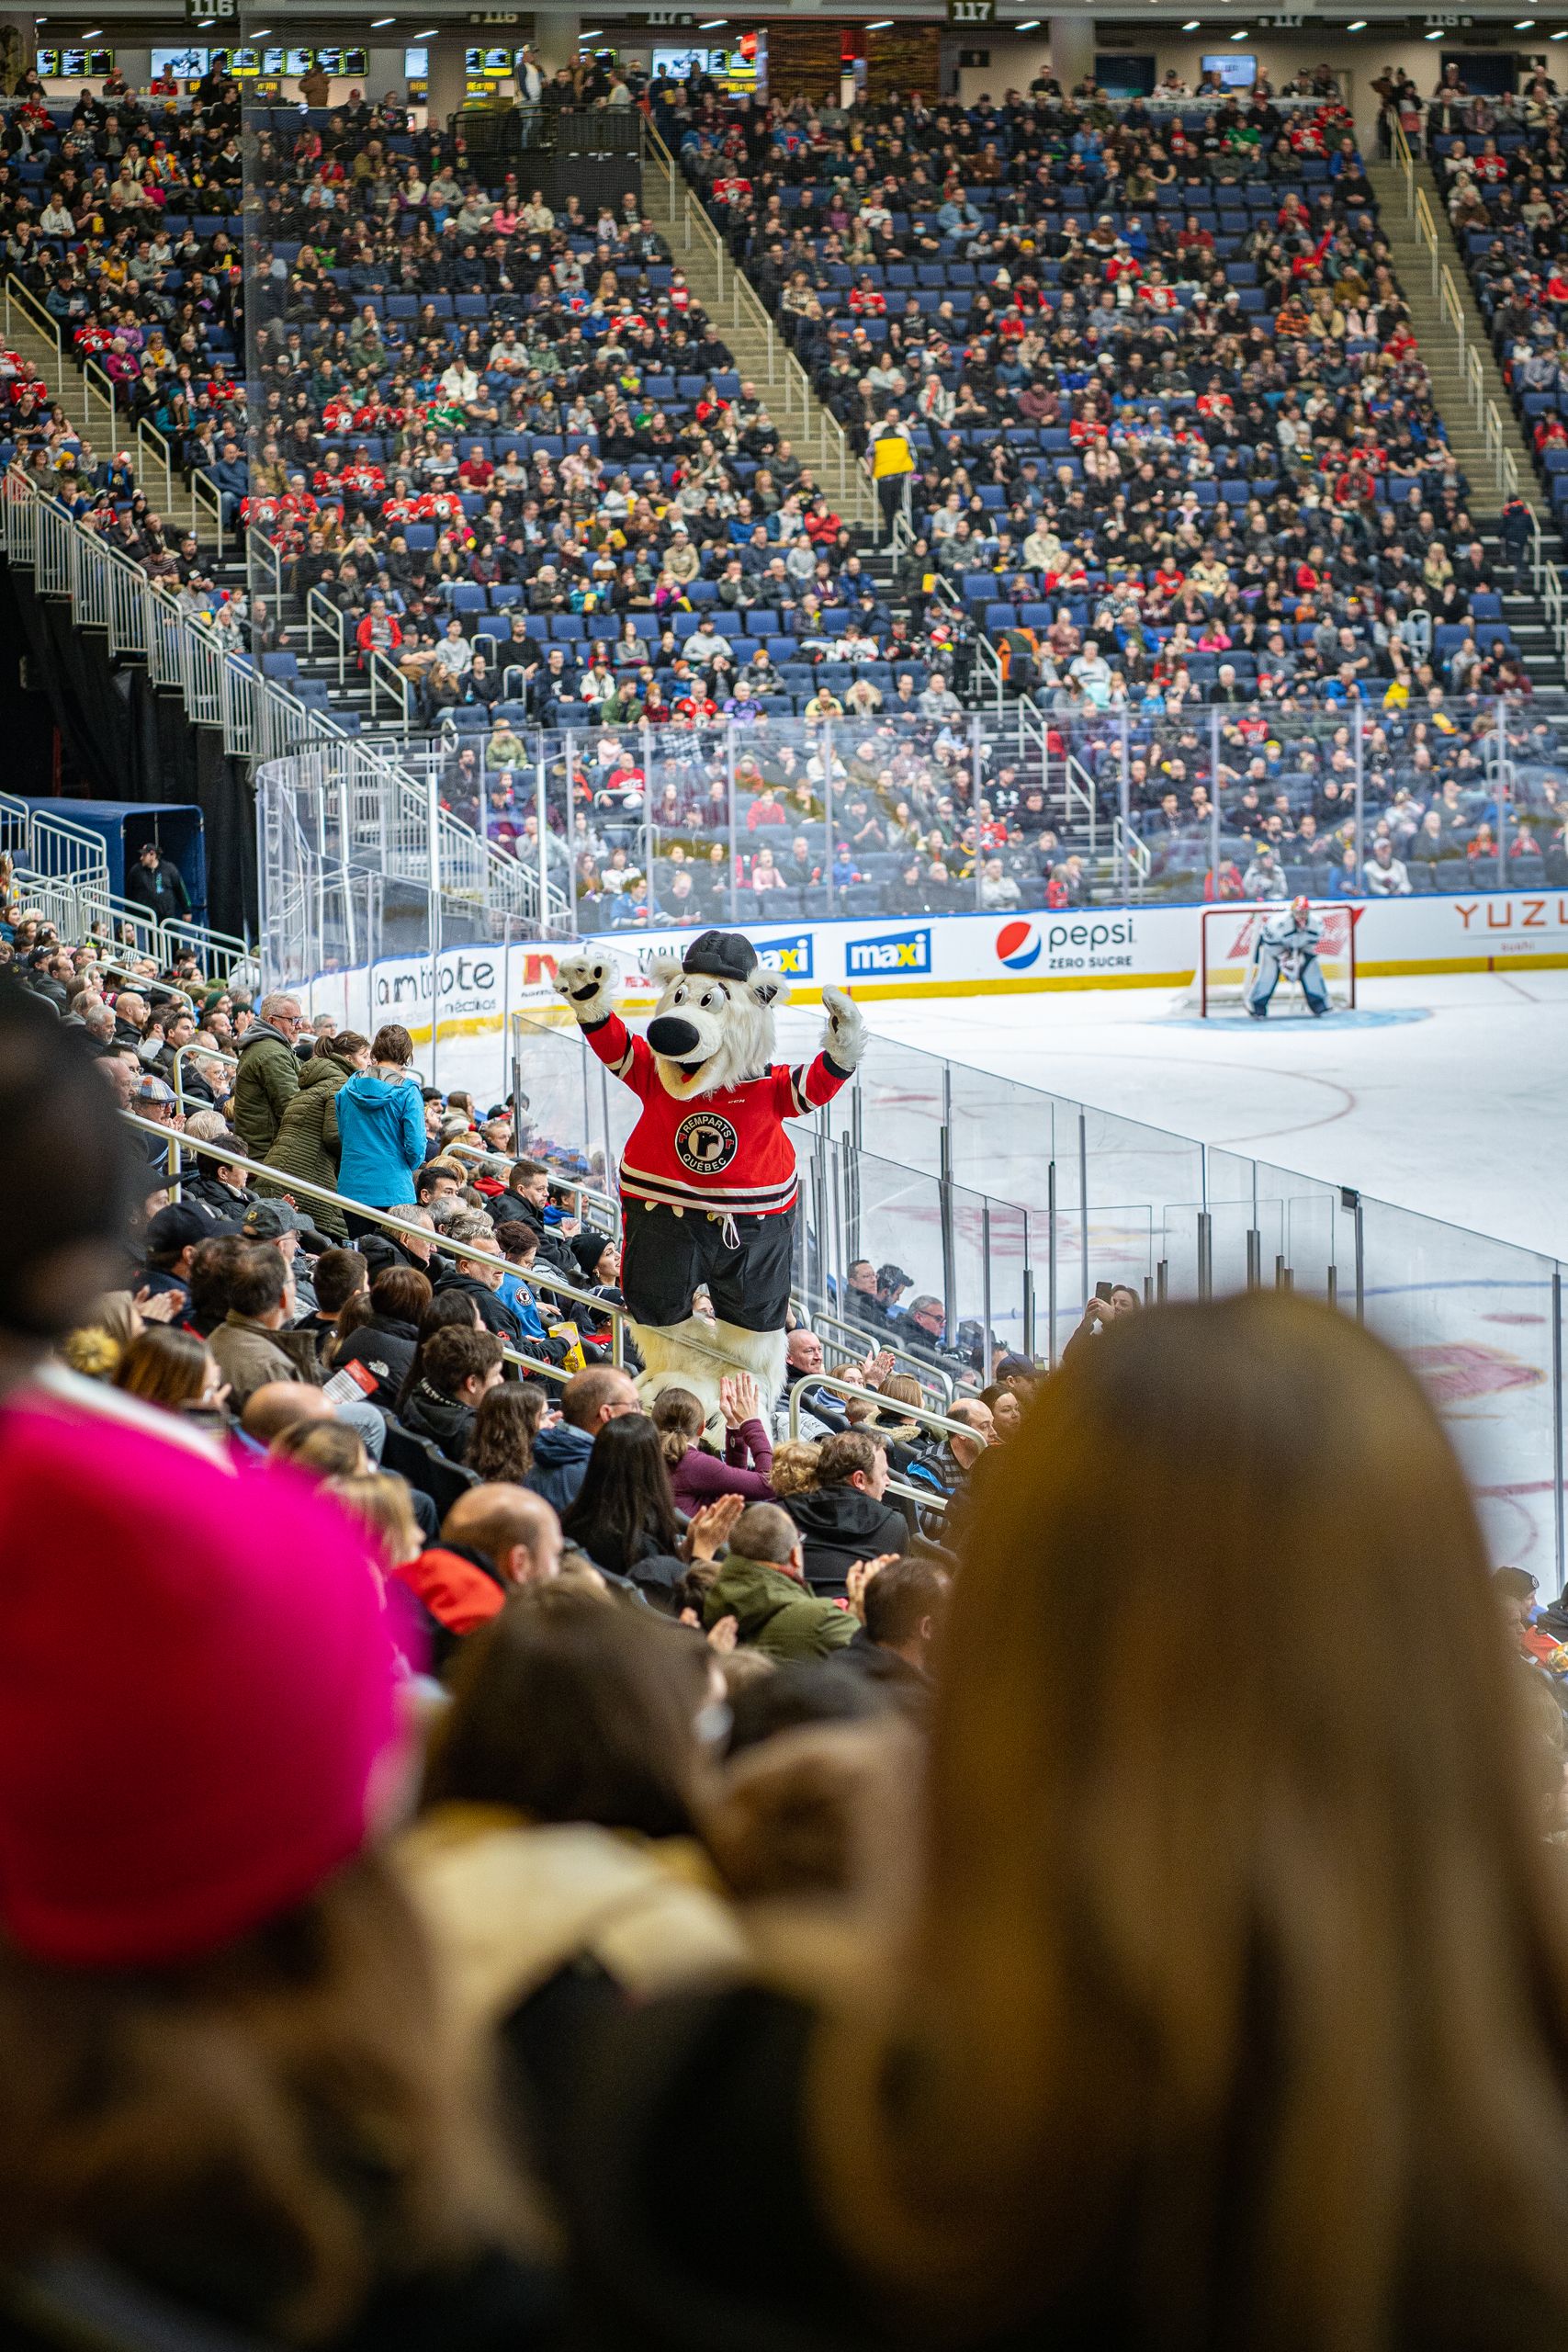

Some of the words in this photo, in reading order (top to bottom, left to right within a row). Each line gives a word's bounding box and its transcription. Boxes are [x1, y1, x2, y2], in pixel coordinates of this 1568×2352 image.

[191, 0, 234, 17] 116
[953, 2, 991, 20] 117
[1049, 918, 1133, 953] pepsi
[851, 933, 926, 969] maxi
[1050, 957, 1083, 968] ZERO
[1090, 956, 1133, 967] SUCRE
[682, 1115, 731, 1137] REMPARTS
[682, 1153, 727, 1171] QUÉBEC
